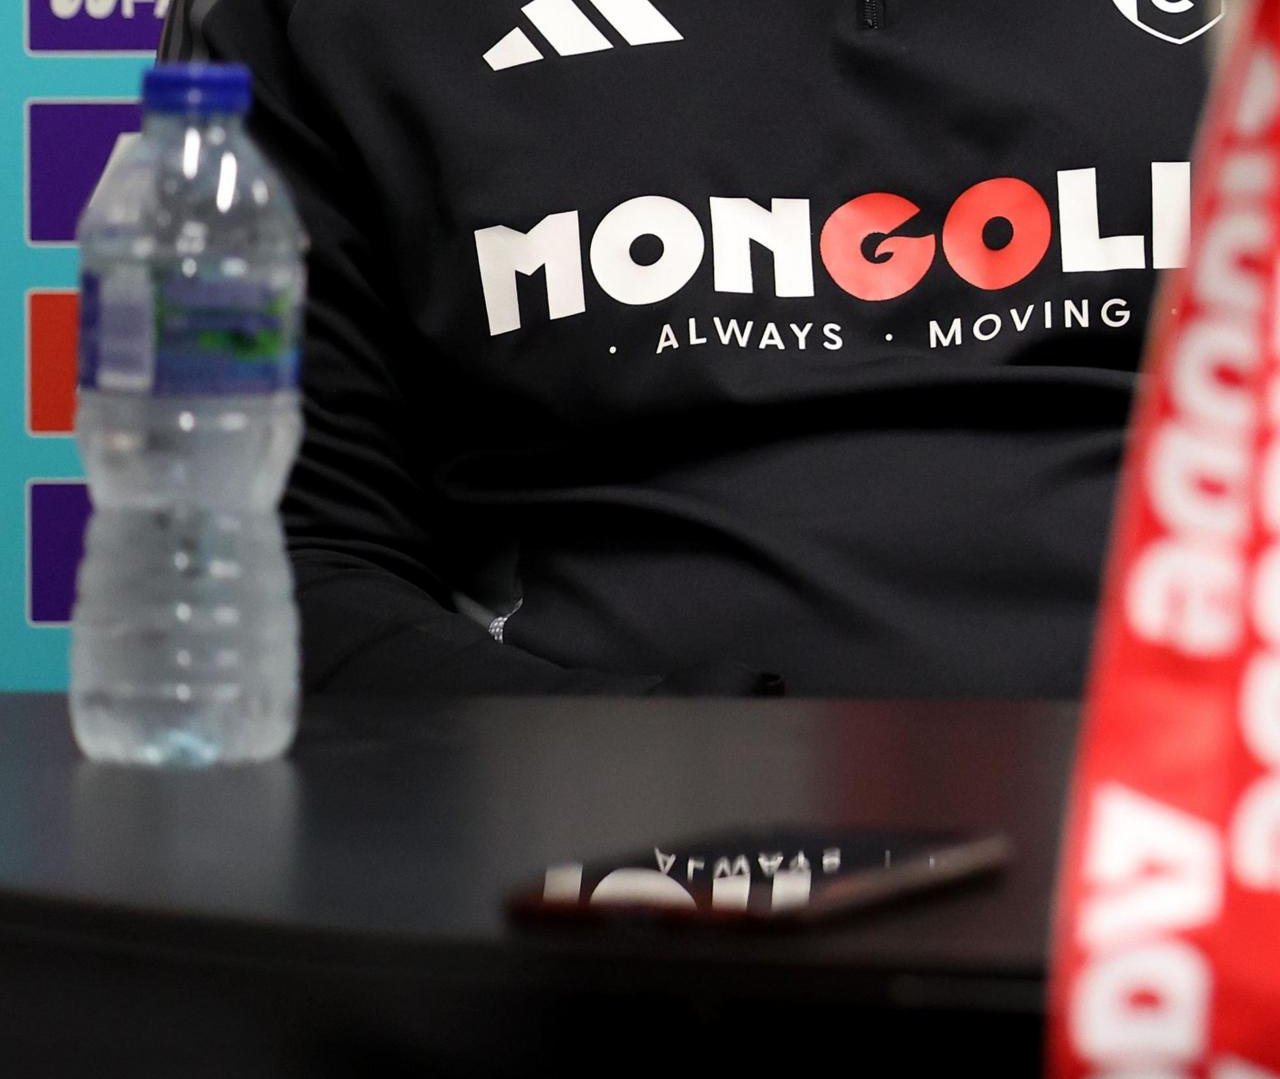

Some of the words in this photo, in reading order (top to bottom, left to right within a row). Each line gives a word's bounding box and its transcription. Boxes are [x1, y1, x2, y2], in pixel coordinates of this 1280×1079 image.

[474, 162, 1190, 336] MONGOLI
[656, 317, 843, 354] ALWAYS
[929, 298, 1131, 348] MOVING
